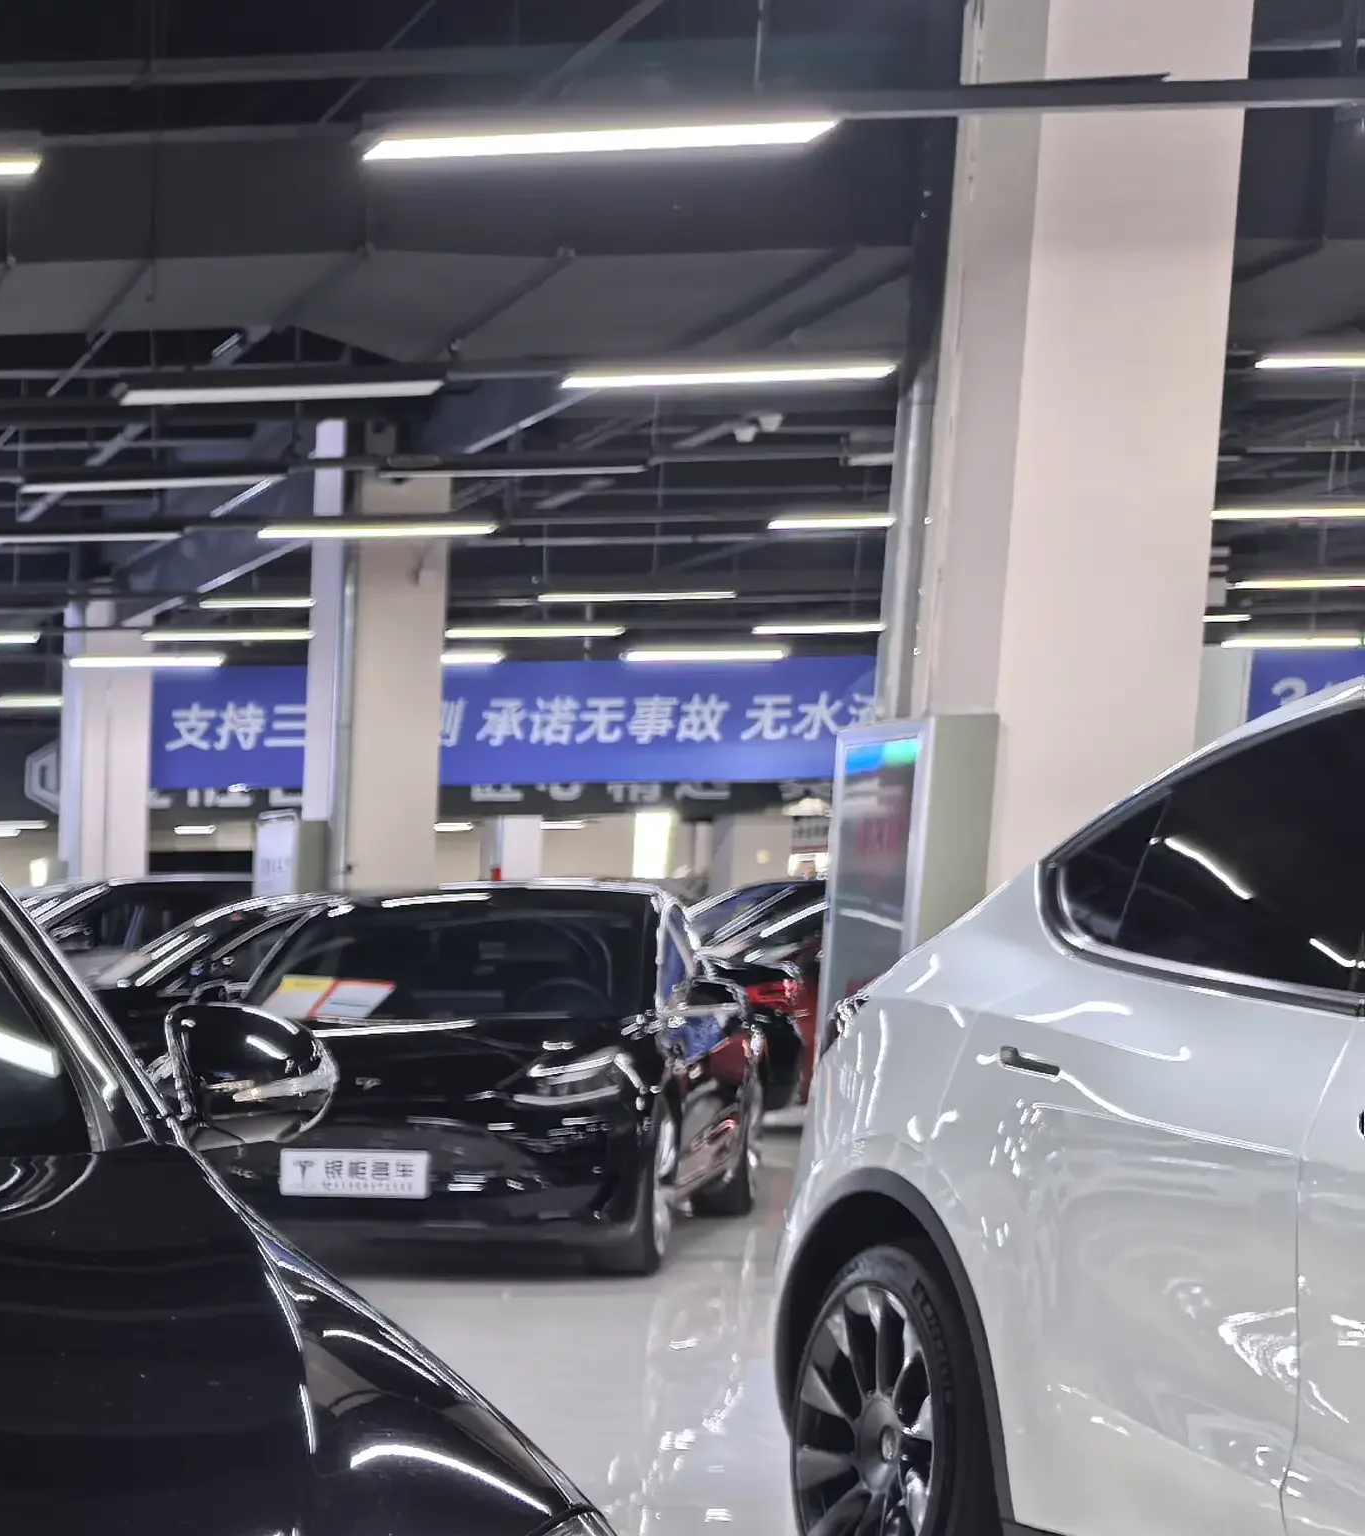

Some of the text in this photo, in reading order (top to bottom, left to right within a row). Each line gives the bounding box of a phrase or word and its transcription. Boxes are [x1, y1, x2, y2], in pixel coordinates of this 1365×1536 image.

[475, 693, 731, 747] 承诺无事故
